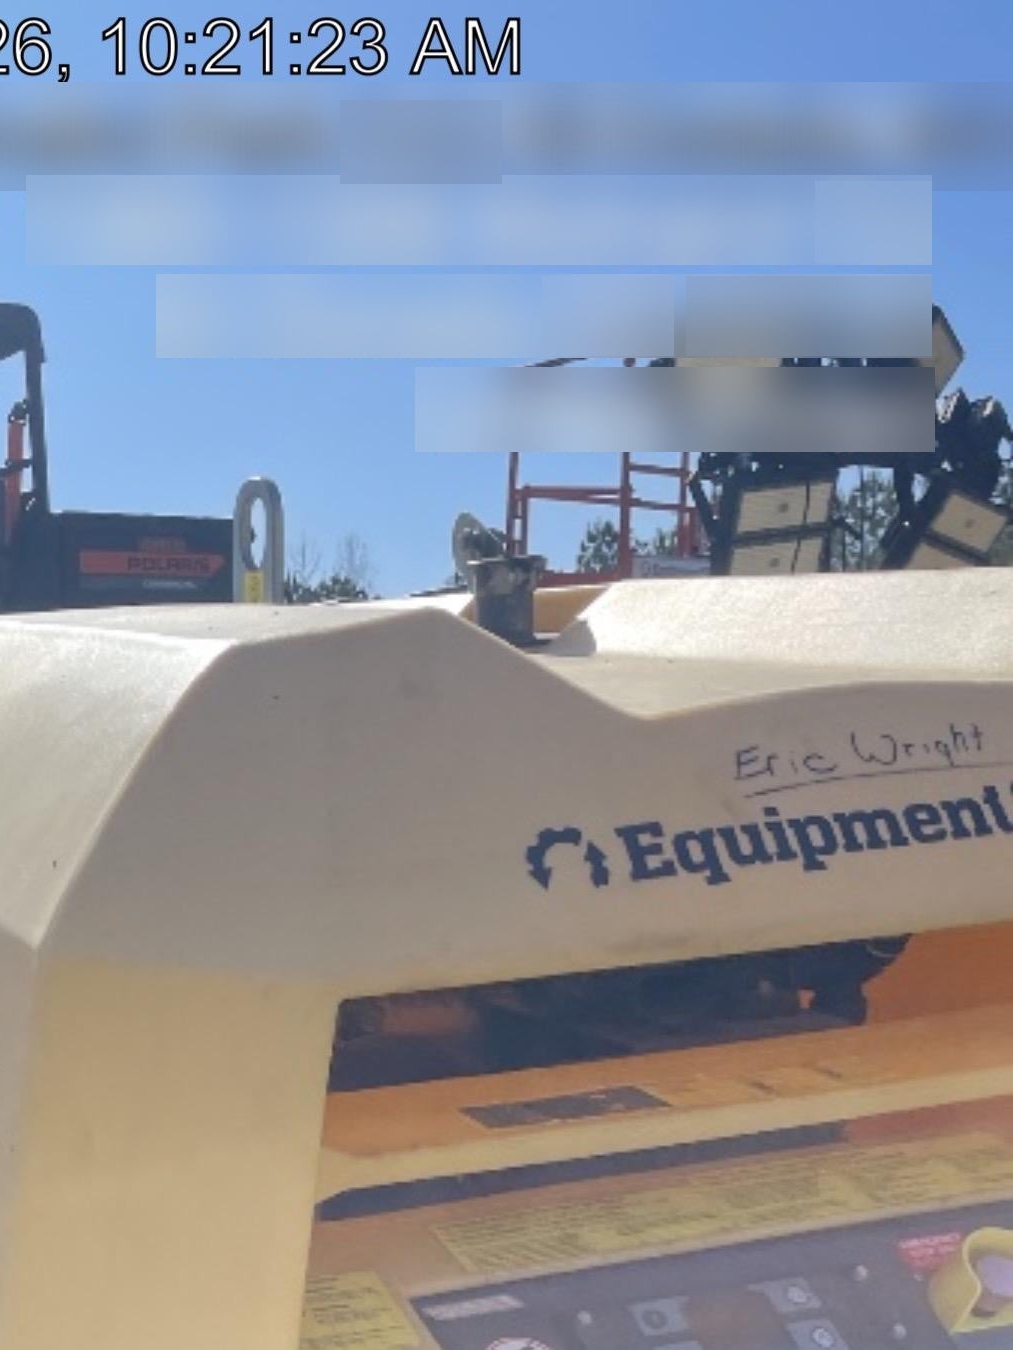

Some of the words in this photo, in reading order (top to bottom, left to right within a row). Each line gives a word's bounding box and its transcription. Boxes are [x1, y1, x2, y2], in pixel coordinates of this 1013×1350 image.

[733, 744, 838, 781] Eric
[850, 722, 984, 767] Wright
[613, 783, 1013, 886] Equipment
